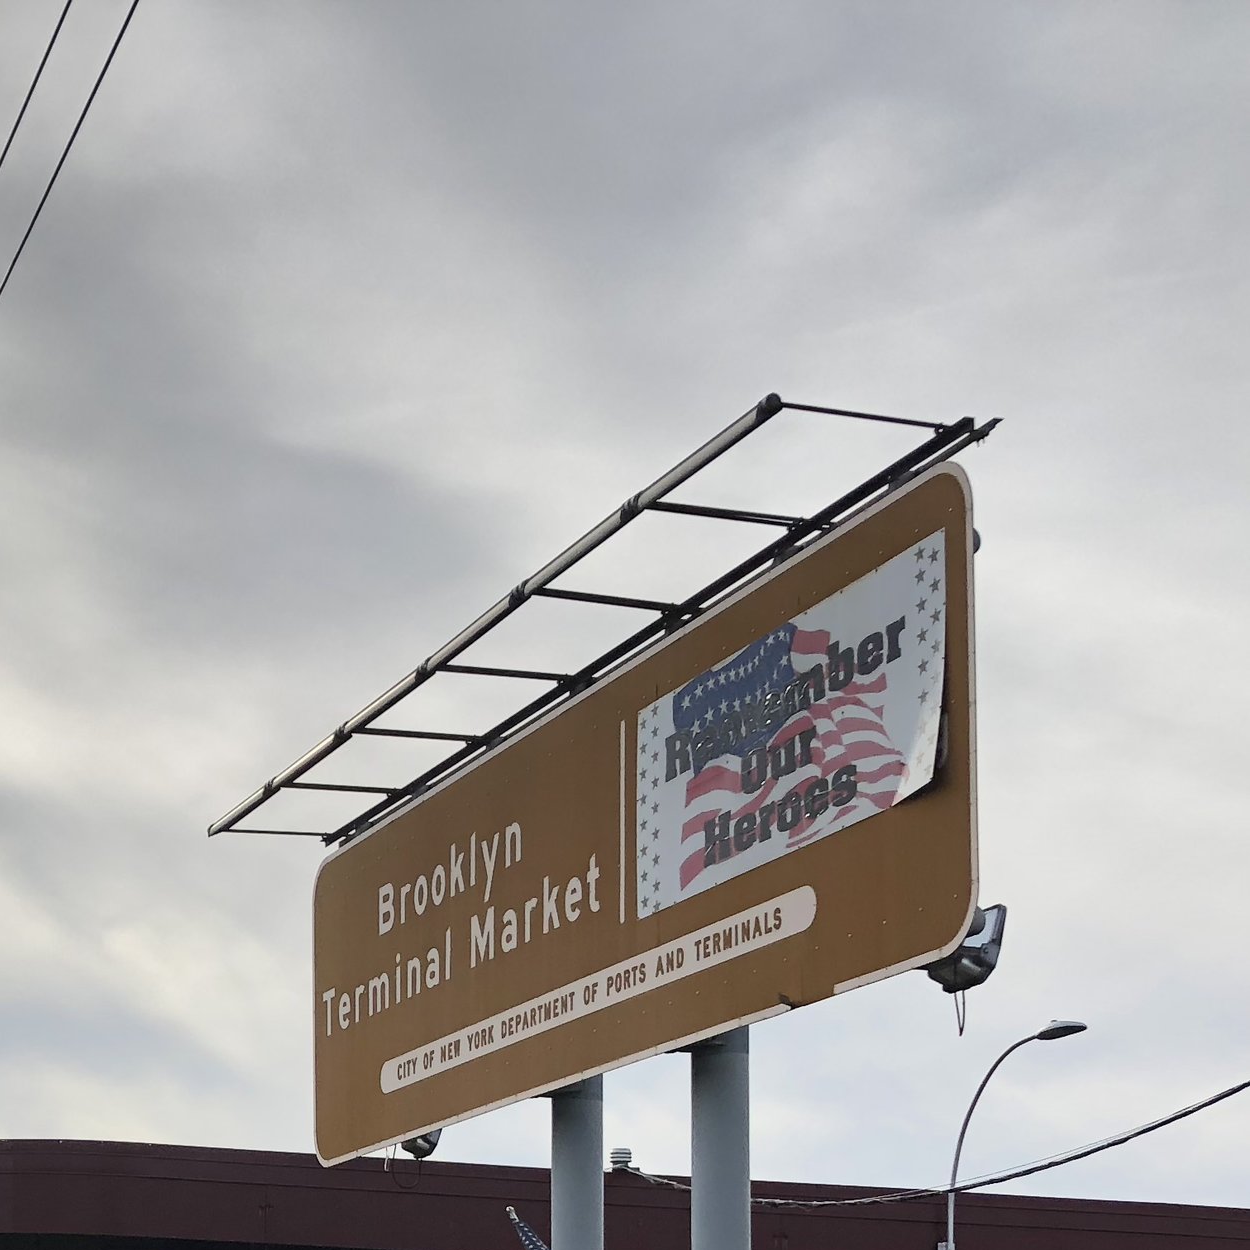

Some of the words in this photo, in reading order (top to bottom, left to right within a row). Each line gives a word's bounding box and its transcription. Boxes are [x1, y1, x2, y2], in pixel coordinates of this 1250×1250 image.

[664, 614, 906, 783] Remember
[740, 725, 817, 795] Our
[377, 821, 523, 937] Brooklyn
[703, 764, 858, 868] Heroes
[322, 925, 452, 1037] Terminal
[469, 852, 601, 969] Market
[396, 1056, 418, 1081] CITY
[422, 1049, 435, 1071] OF
[440, 1038, 462, 1064] NEW
[467, 1024, 495, 1051] YORK
[501, 991, 576, 1039] DEPARTMENT
[583, 982, 599, 1005] OF
[606, 963, 647, 997] PORTS
[655, 947, 685, 978] AND
[694, 907, 783, 961] TERMINALS
